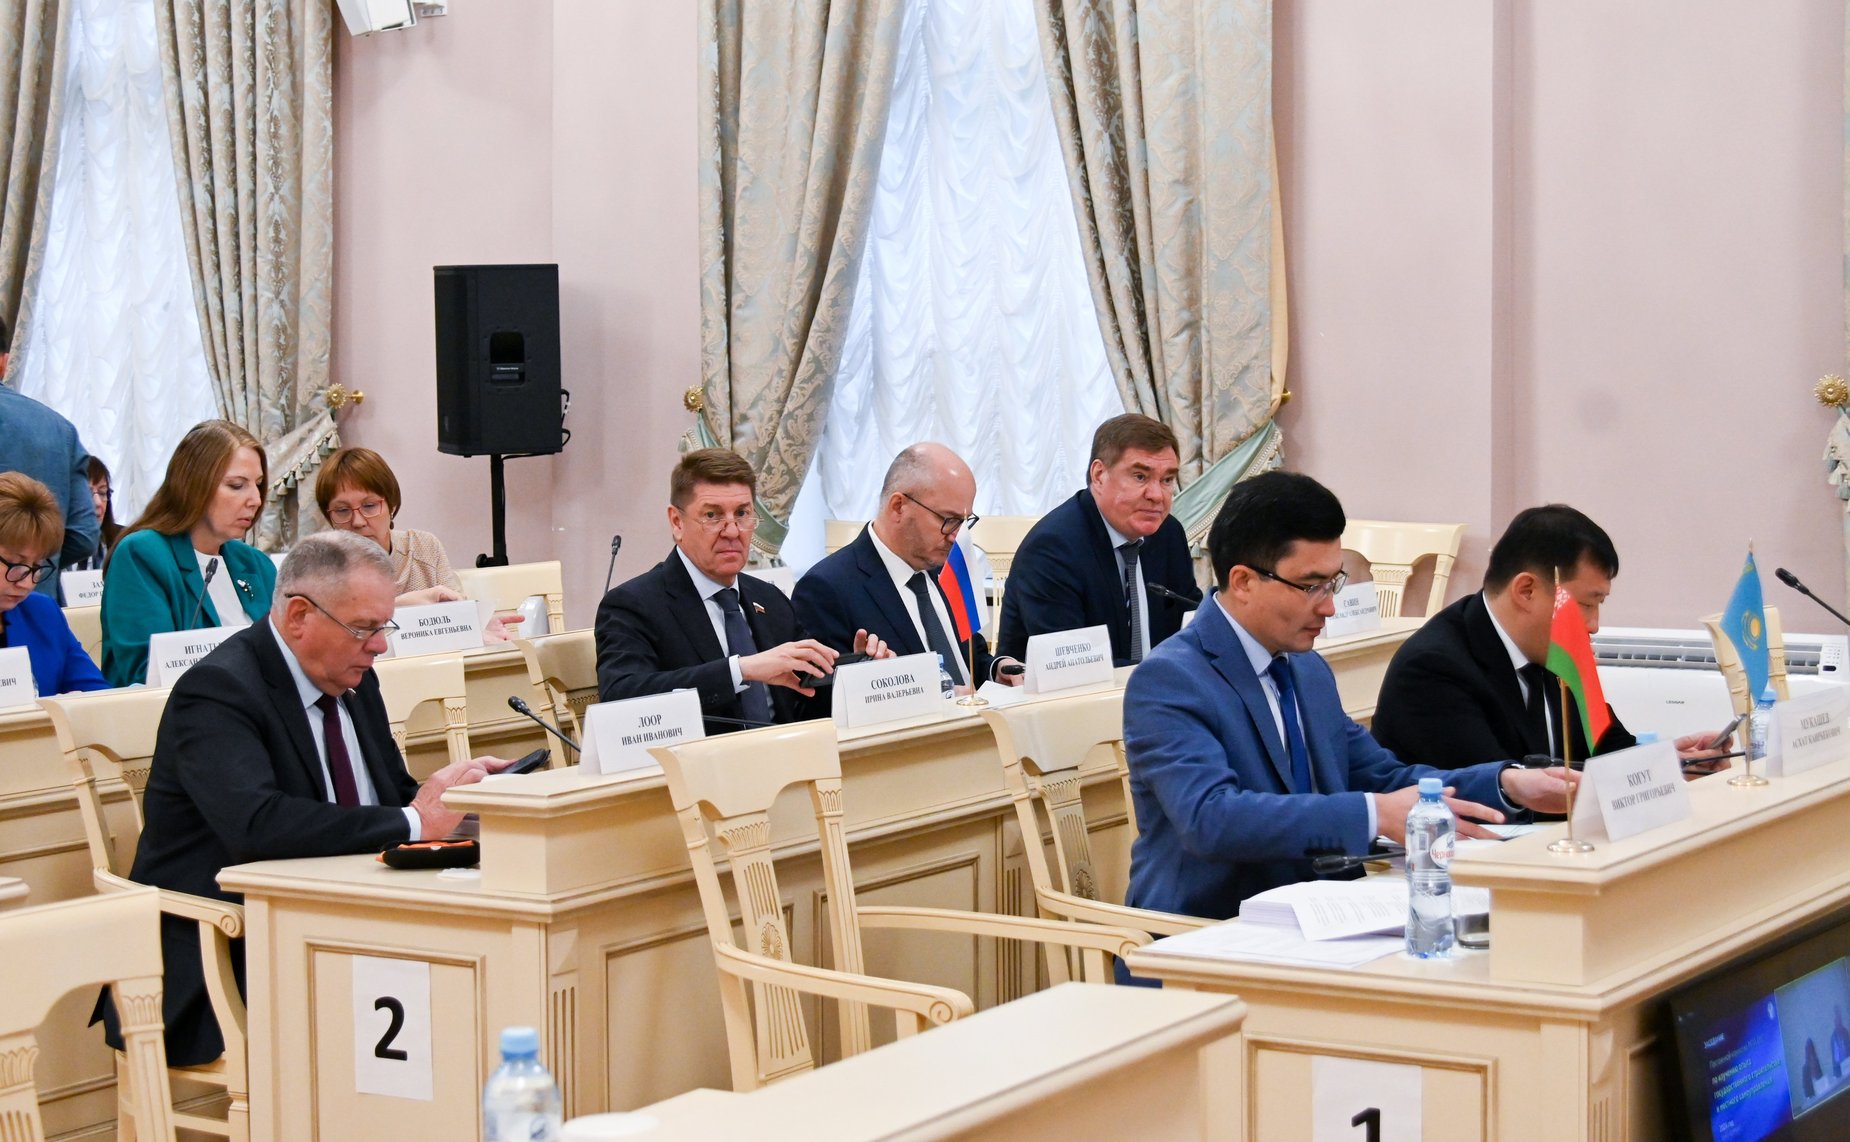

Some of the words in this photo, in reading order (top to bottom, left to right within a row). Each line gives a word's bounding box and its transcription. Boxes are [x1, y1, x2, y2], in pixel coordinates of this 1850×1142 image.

[418, 615, 451, 627] БОДЮЛЬ
[400, 629, 433, 640] ВЕРОНИКА
[434, 624, 473, 636] ЕВГЕНЬЕВНА
[184, 642, 221, 655] ИГНАТ
[1055, 642, 1092, 657] ШЕВЧЕНКО
[165, 657, 202, 669] АЛЕКСАН
[1045, 658, 1067, 671] АНДРЕЙ
[1067, 653, 1104, 667] АНАТОЛЬЕВИЧ
[870, 673, 916, 690] СОКОЛОВА
[865, 693, 886, 704] ИРИНА
[887, 686, 924, 700] ВАЛЕРЬЕВНА
[638, 714, 662, 729] ЛООР
[1800, 712, 1830, 730] МУКАШЕВ
[621, 734, 642, 746] ИВАН
[643, 727, 683, 743] ИВАНОВИЧ
[1627, 768, 1652, 788] КОГУТ
[1611, 795, 1635, 811] ВИКТОР
[1635, 782, 1677, 806] ГРИГОРЬЕВИЧ
[374, 996, 408, 1061] 2
[1351, 1107, 1381, 1142] 1
